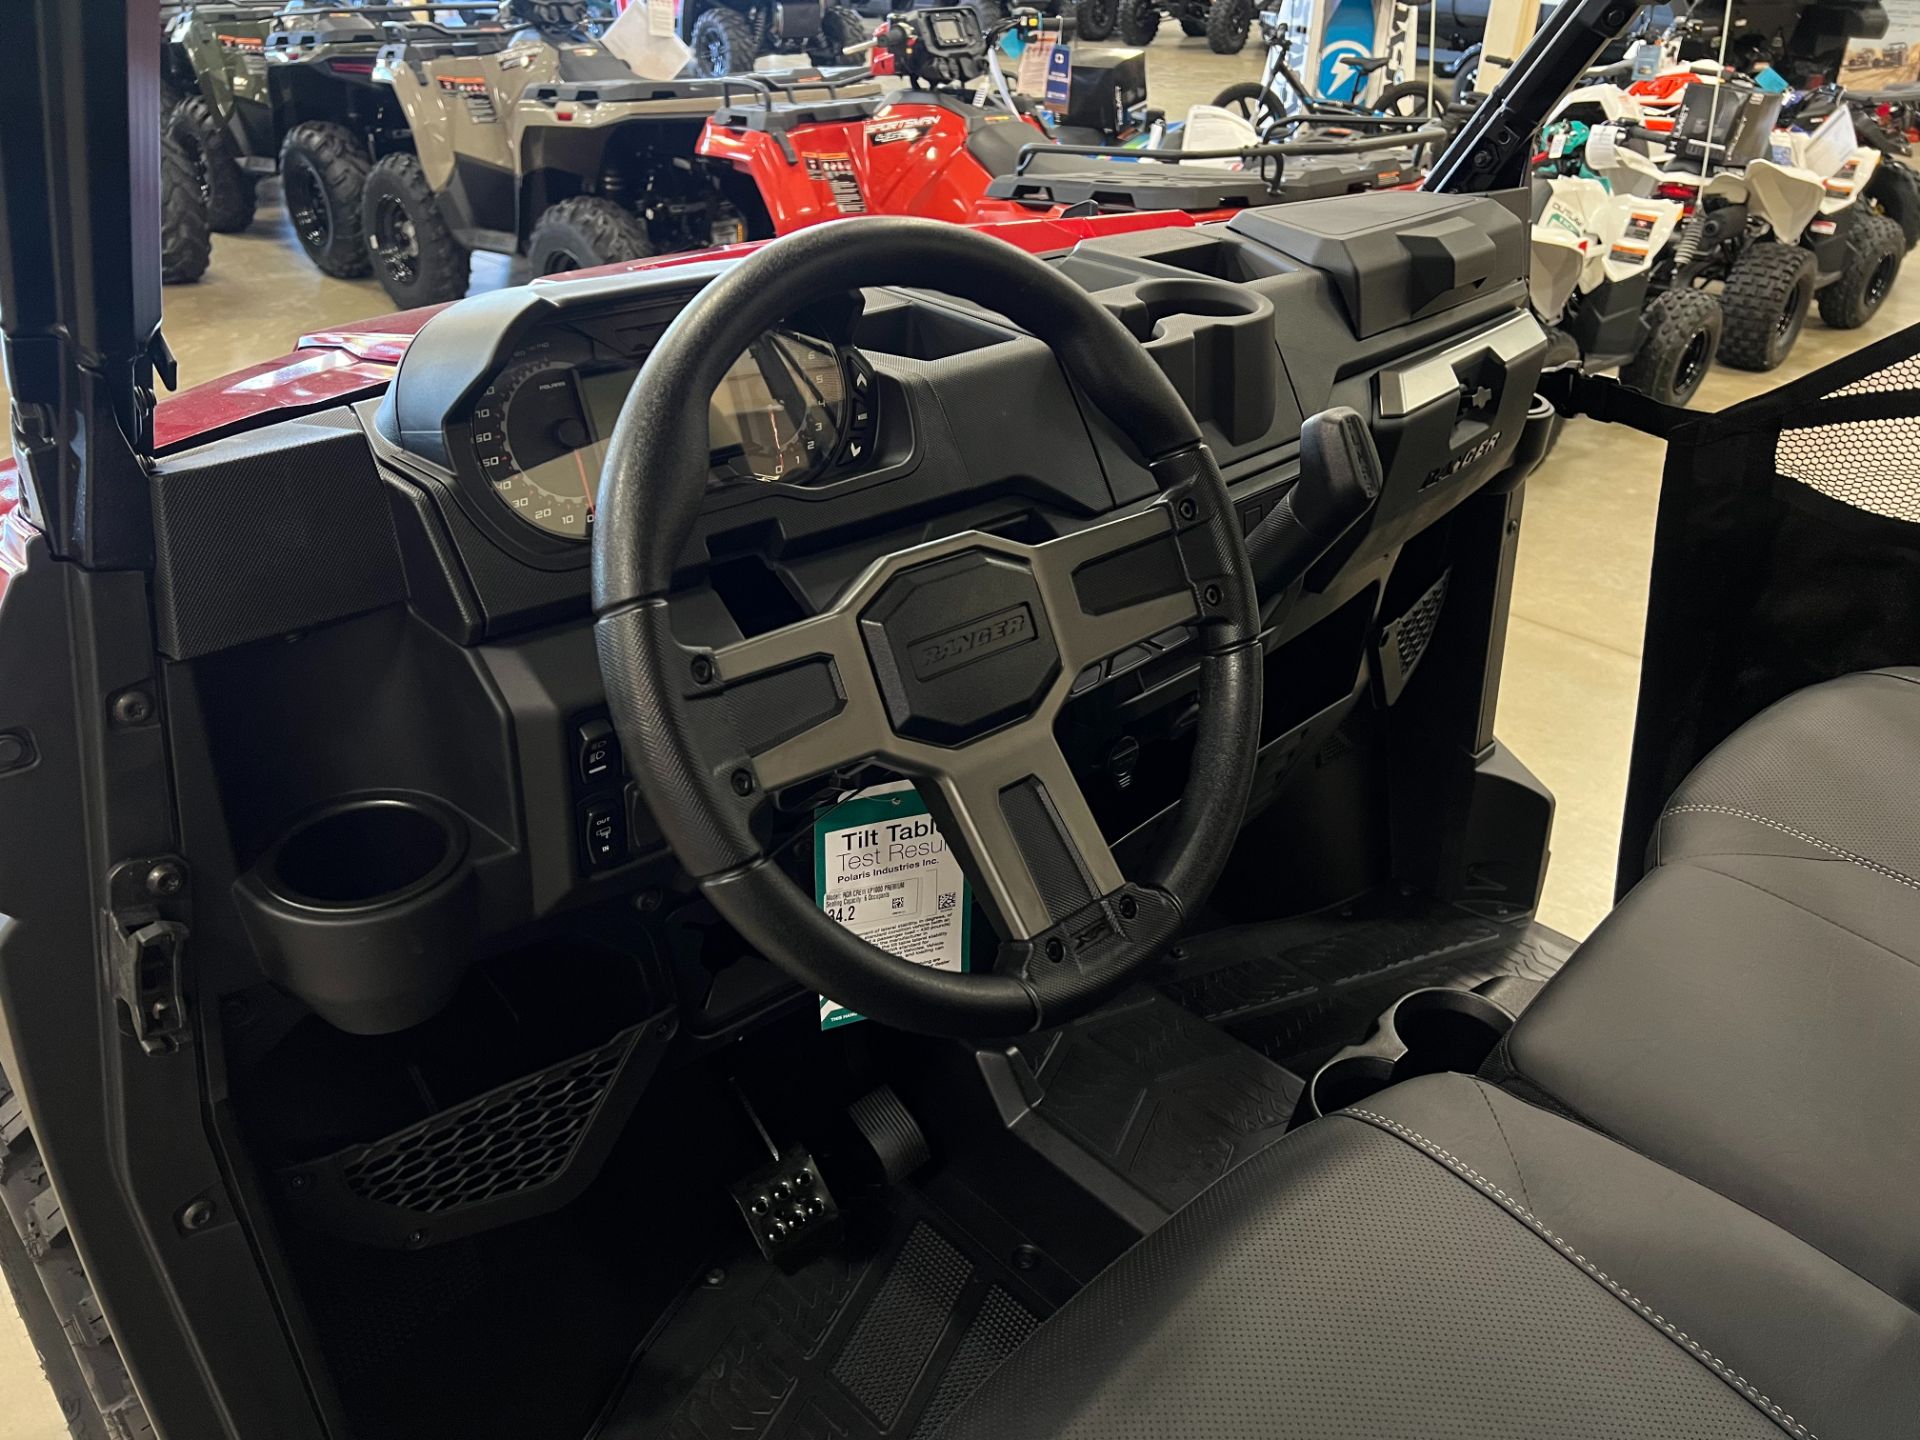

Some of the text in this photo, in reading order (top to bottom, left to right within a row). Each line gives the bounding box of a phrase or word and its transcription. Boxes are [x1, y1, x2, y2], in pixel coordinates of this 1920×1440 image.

[815, 422, 823, 432] 3
[807, 441, 815, 450] 2
[795, 456, 800, 464] 1
[511, 497, 529, 509] 30
[534, 508, 552, 519] 20
[561, 514, 574, 525] 10
[922, 614, 1025, 666] RANGER
[597, 817, 611, 826] OUT
[842, 829, 879, 851] Tilt
[602, 845, 610, 853] IN
[836, 848, 881, 872] Test
[837, 857, 940, 884] Polaris Industries Inc.
[826, 900, 843, 909] Seating
[828, 905, 856, 923] 34.2
[889, 933, 922, 943] manufacturer
